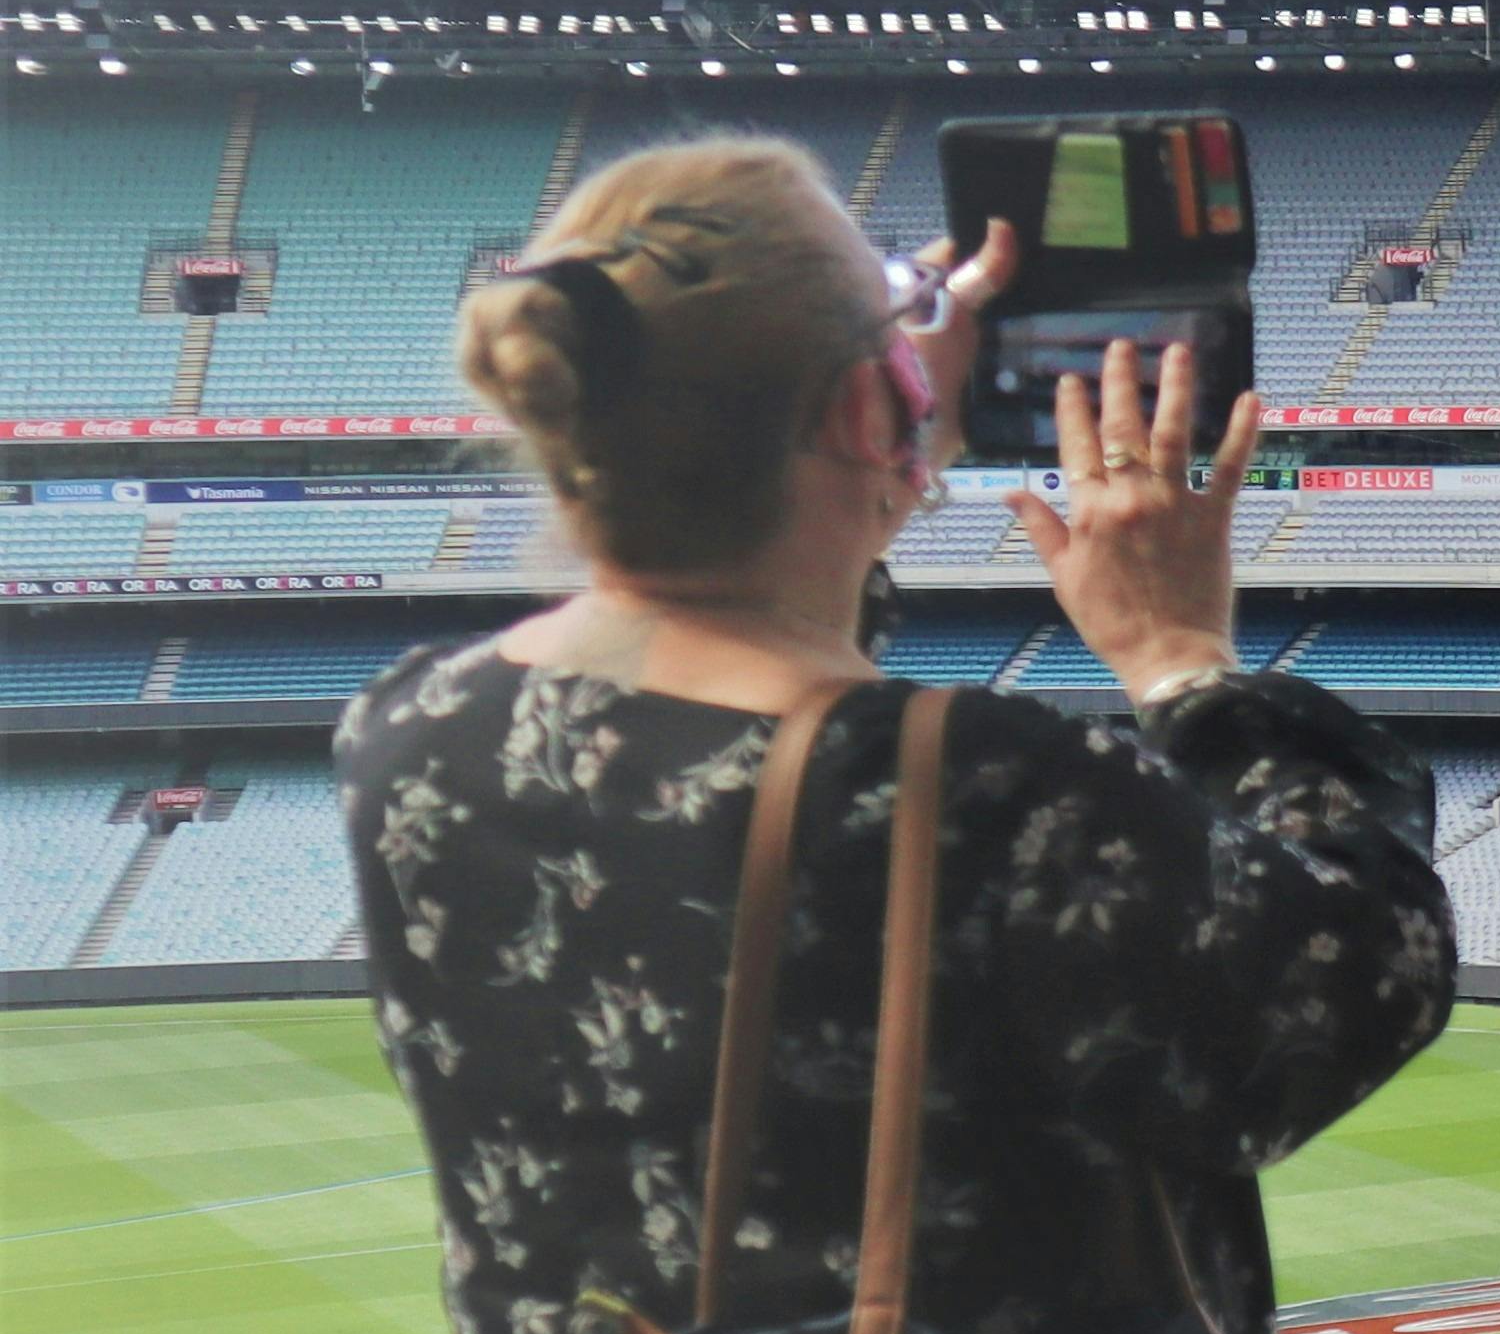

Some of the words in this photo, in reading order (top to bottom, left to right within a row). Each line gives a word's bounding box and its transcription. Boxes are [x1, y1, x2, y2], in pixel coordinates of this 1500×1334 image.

[201, 486, 264, 499] Tasmania
[304, 486, 363, 495] NISSAN
[370, 485, 429, 494] NISSAN
[435, 484, 492, 493] NISSAN
